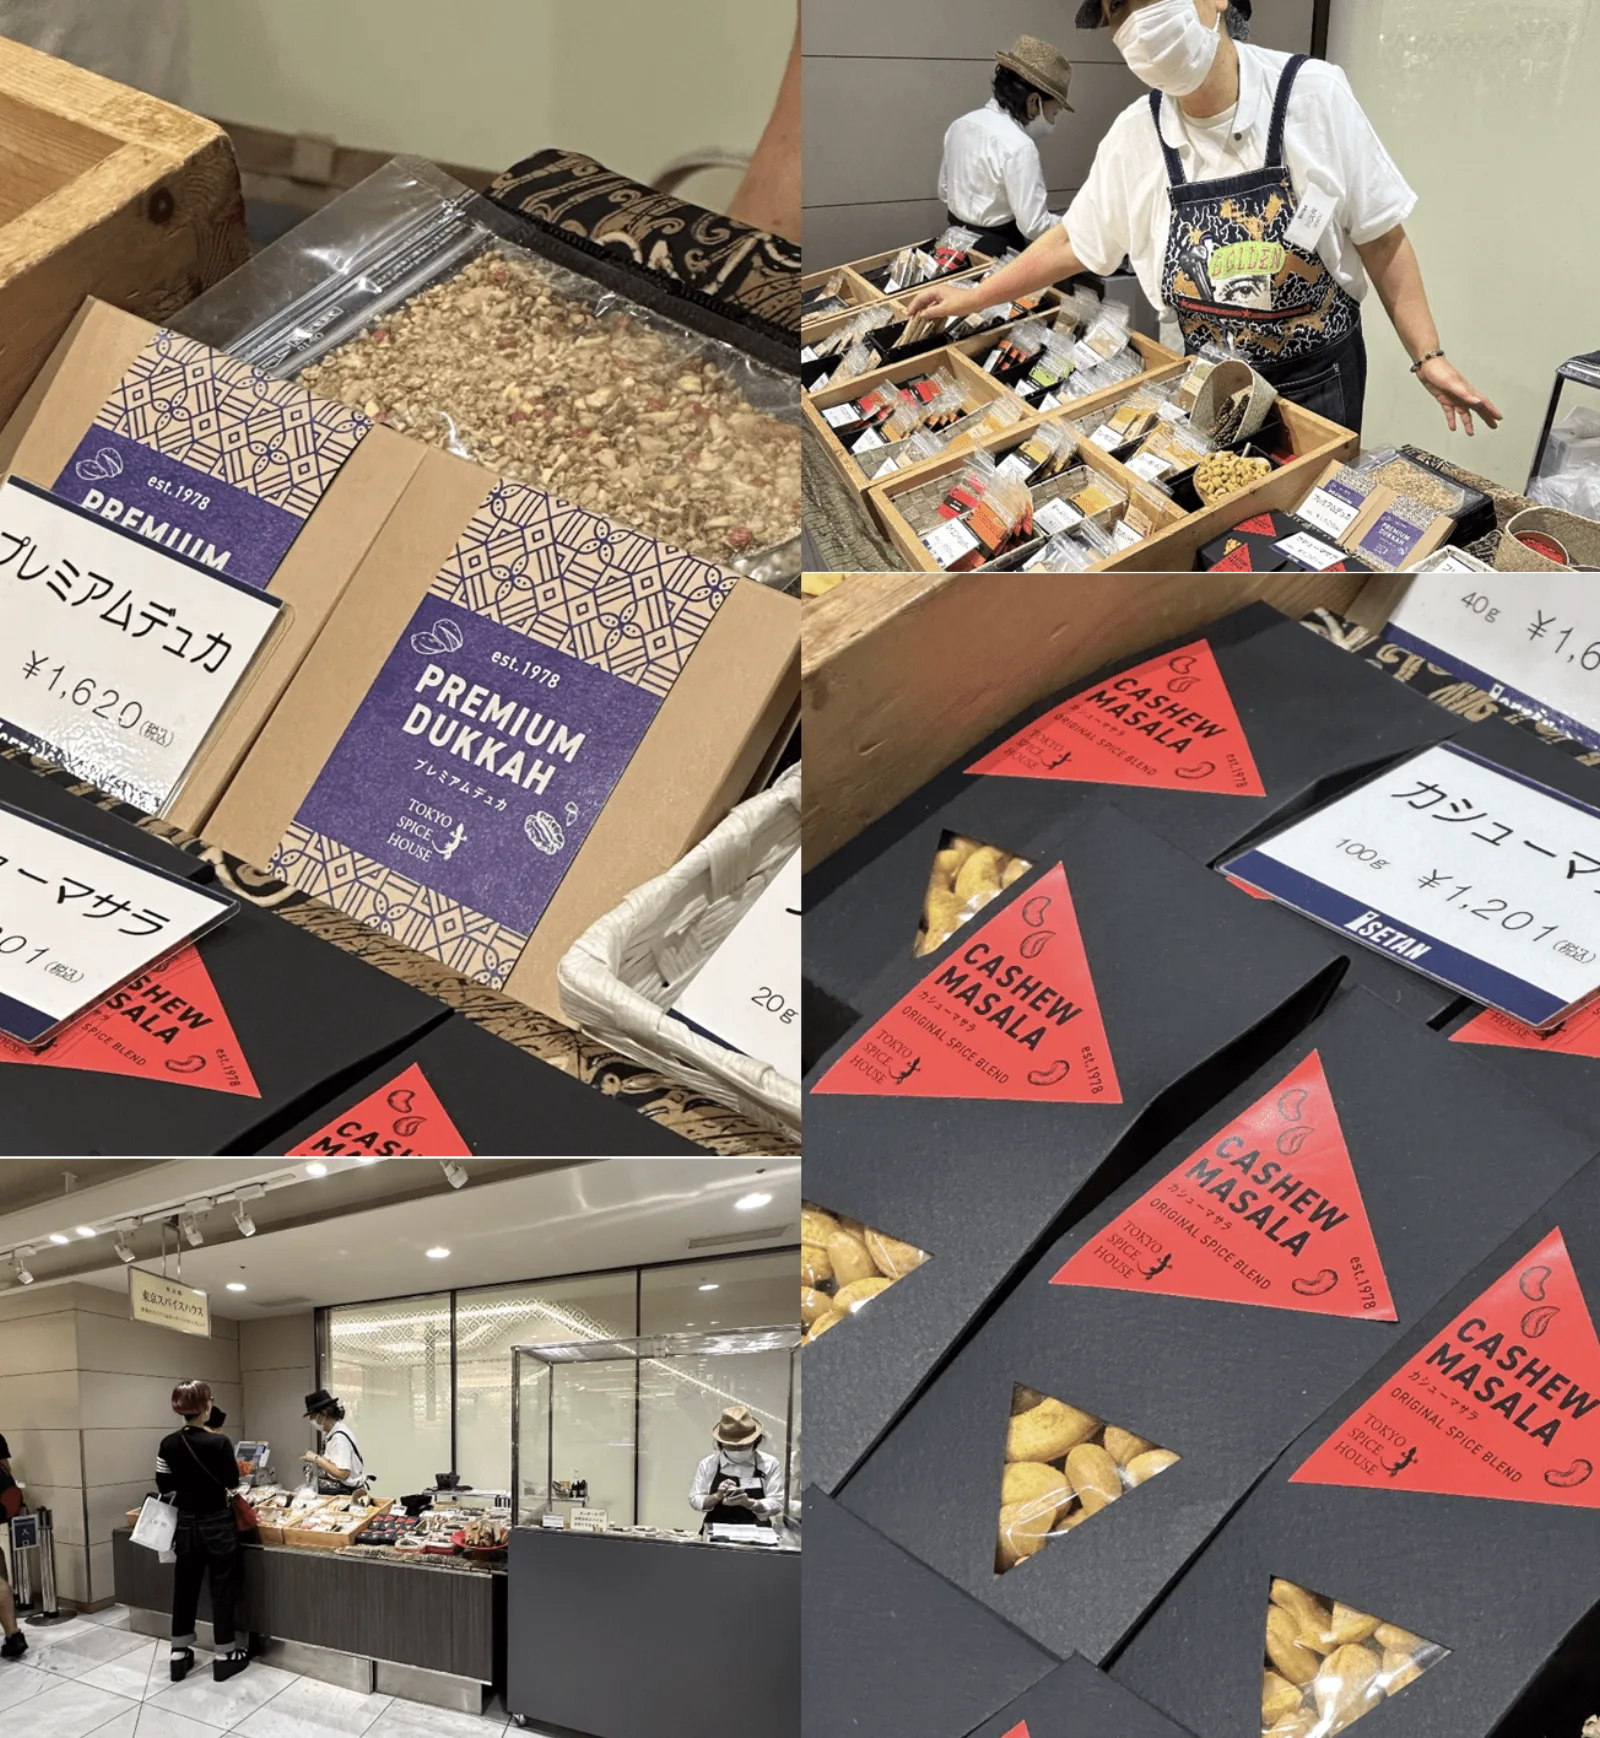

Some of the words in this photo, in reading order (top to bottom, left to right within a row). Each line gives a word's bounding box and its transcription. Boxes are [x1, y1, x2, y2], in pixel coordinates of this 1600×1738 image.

[148, 474, 211, 511] est.1978
[0, 530, 232, 673] プレミアムデュカ
[1461, 592, 1502, 624] 40g
[491, 650, 561, 689] est.1978
[414, 663, 586, 763] PREMIUM
[1085, 690, 1194, 755] MASALA
[1113, 677, 1228, 739] CASHEW
[402, 702, 556, 795] DUKKAH
[1053, 713, 1097, 742] ORIGINAL
[1099, 737, 1125, 758] SPICE
[1124, 752, 1158, 777] BLEND
[1225, 752, 1248, 788] est.1978
[414, 759, 508, 812] プレミアムデュカ
[396, 815, 433, 842] SPICE
[408, 798, 452, 828] TOKYO
[1391, 780, 1600, 895] カシューマ
[387, 832, 433, 863] HOUSE
[1335, 837, 1390, 870] 100g
[0, 855, 171, 936] ーマサラ
[1343, 910, 1432, 961] ISETAN
[127, 974, 213, 1030] SHEW
[751, 986, 799, 1024] 20g
[933, 964, 1048, 1052] MASALA
[962, 942, 1084, 1027] CASHEW
[104, 992, 180, 1044] SALA
[877, 1028, 912, 1059] TOKYO
[81, 1023, 114, 1046] SPICE
[112, 1042, 147, 1066] BLEND
[216, 1048, 241, 1087] est.1978
[849, 1054, 888, 1086] HOUSE
[862, 1041, 893, 1067] SPICE
[901, 1004, 946, 1042] ORIGINAL
[946, 1037, 975, 1063] SPICE
[975, 1057, 1010, 1085] BLEND
[1081, 1045, 1104, 1095] est.1978
[1183, 1157, 1312, 1258] MASALA
[1214, 1135, 1350, 1233] CASHEW
[1093, 1245, 1136, 1281] HOUSE
[1107, 1233, 1141, 1262] SPICE
[1124, 1220, 1164, 1255] TOKYO
[1149, 1197, 1198, 1239] ORIGINAL
[1199, 1234, 1234, 1264] SPICE
[1232, 1257, 1271, 1291] BLEND
[1349, 1255, 1377, 1311] est.1978
[1456, 1317, 1600, 1420] CASHEW
[1425, 1342, 1563, 1448] MASALA
[1348, 1427, 1385, 1457] SPICE
[1363, 1413, 1407, 1448] TOKYO
[1390, 1386, 1445, 1431] ORIGINAL
[1445, 1425, 1484, 1455] SPICE
[1481, 1447, 1523, 1484] BLEND
[1334, 1440, 1378, 1477] HOUSE
